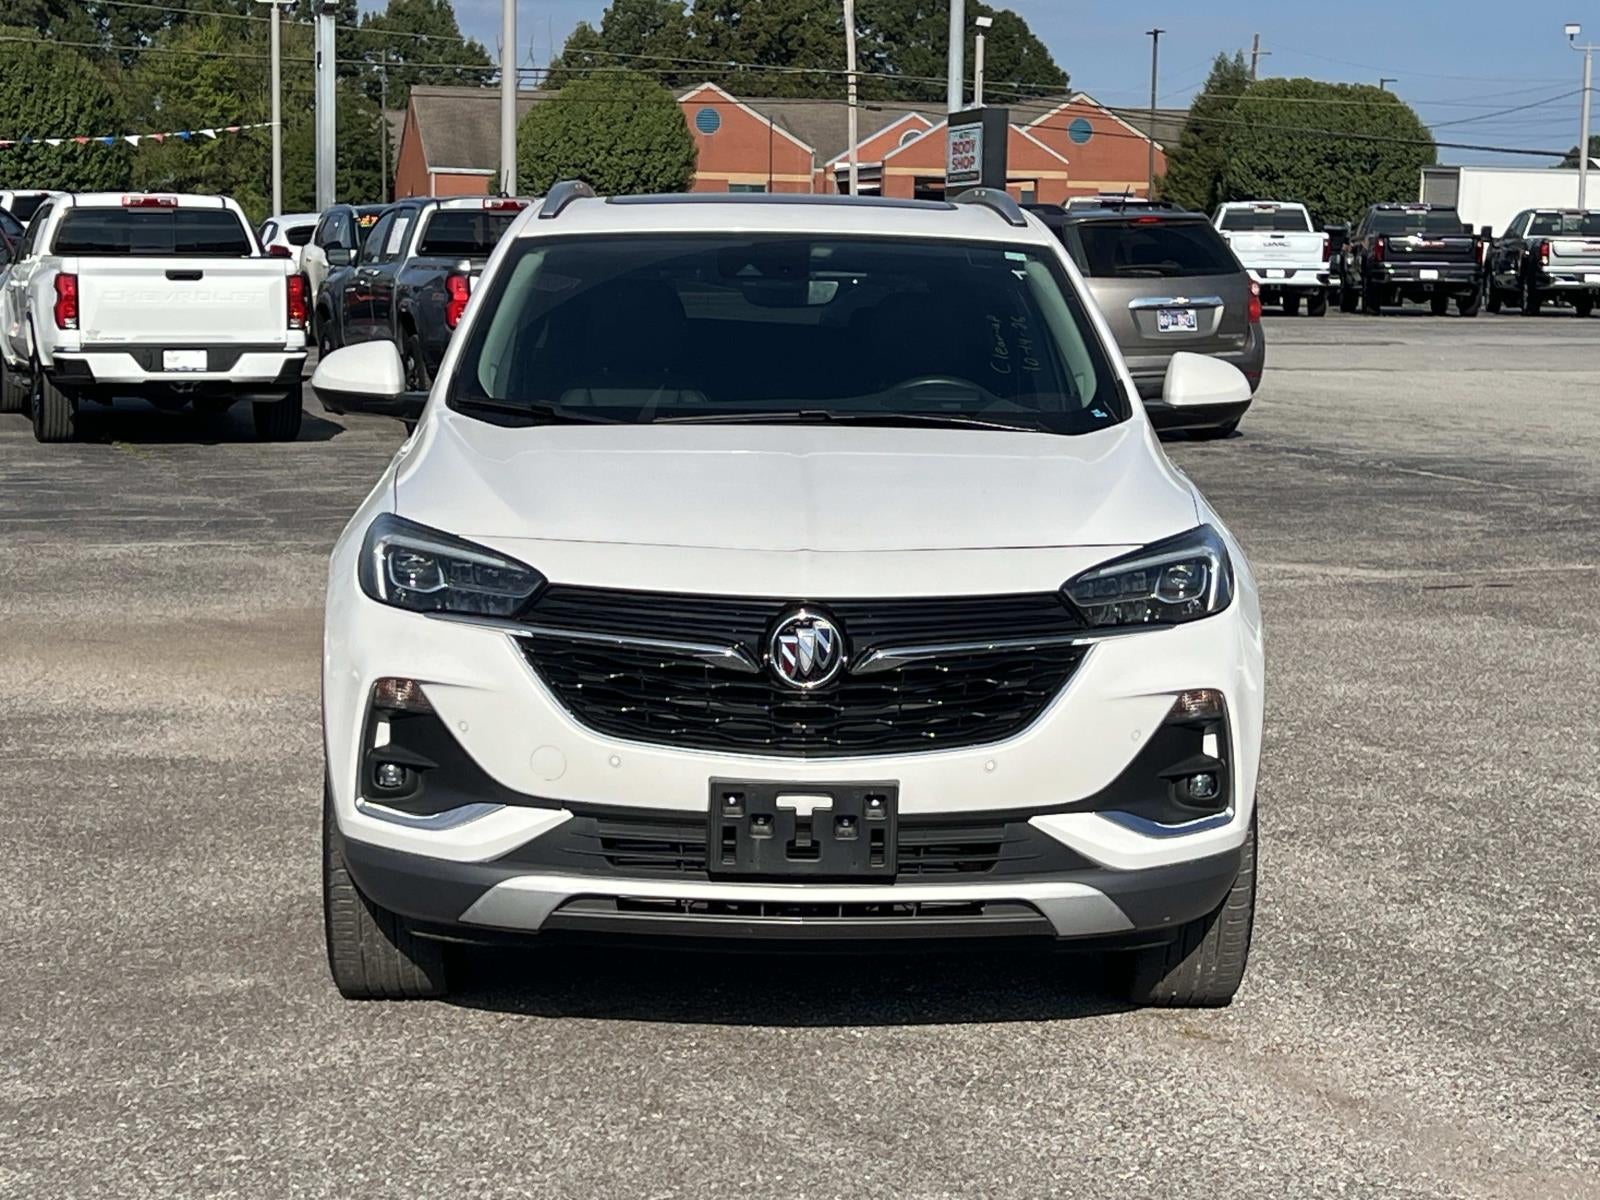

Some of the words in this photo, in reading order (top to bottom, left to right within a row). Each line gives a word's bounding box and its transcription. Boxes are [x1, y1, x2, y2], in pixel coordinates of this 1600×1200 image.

[952, 140, 976, 155] BODY
[952, 156, 976, 170] SHOP
[101, 289, 265, 303] CHEVROLET
